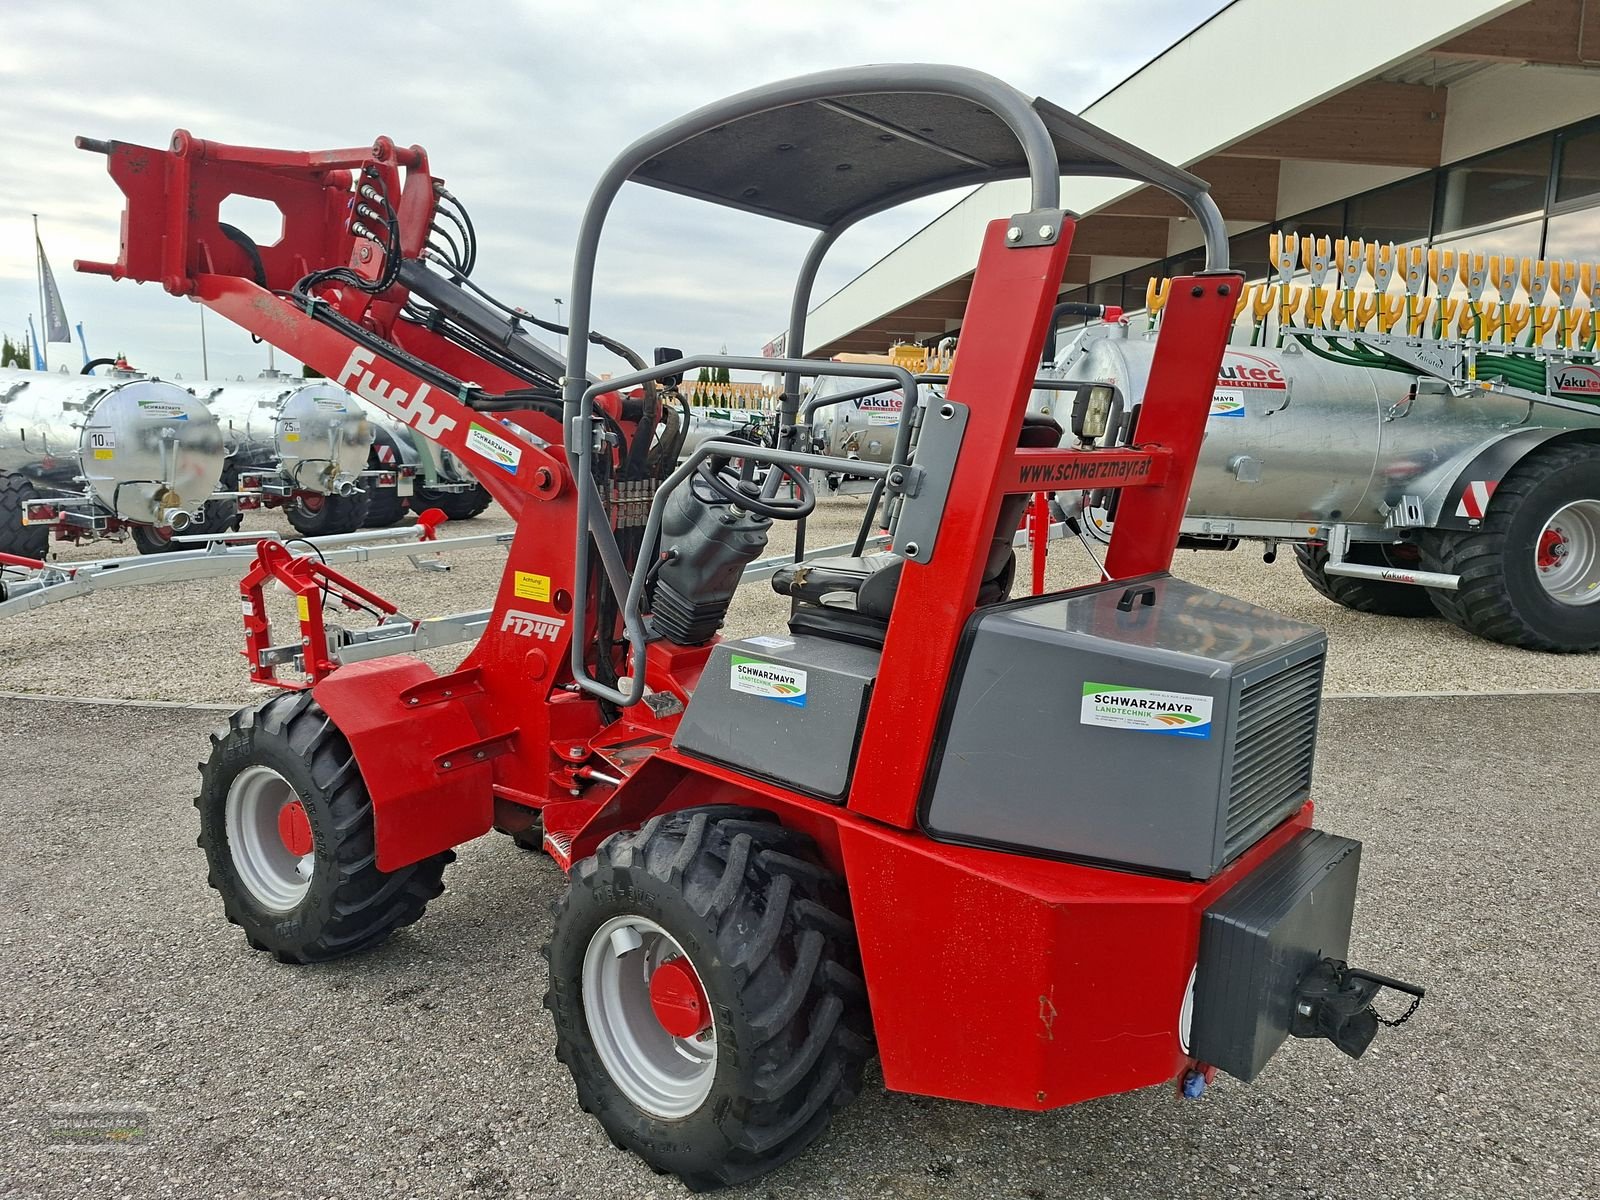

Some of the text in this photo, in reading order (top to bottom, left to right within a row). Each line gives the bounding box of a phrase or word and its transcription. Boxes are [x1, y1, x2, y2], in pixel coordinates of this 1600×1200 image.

[1554, 372, 1600, 390] Vakute
[337, 345, 457, 440] Fuchs
[854, 396, 903, 410] Vakute
[284, 422, 294, 432] 25
[92, 433, 104, 447] 10
[473, 430, 513, 456] SCHWARZMAYR
[1019, 456, 1152, 483] www.schwarzmayr.at
[1381, 570, 1415, 581] Vakutec
[500, 609, 566, 643] F1244
[737, 665, 796, 686] SCHWARZMAYR
[1094, 694, 1193, 714] SCHWARZMAYR
[1095, 705, 1153, 718] LANDTECHNIK
